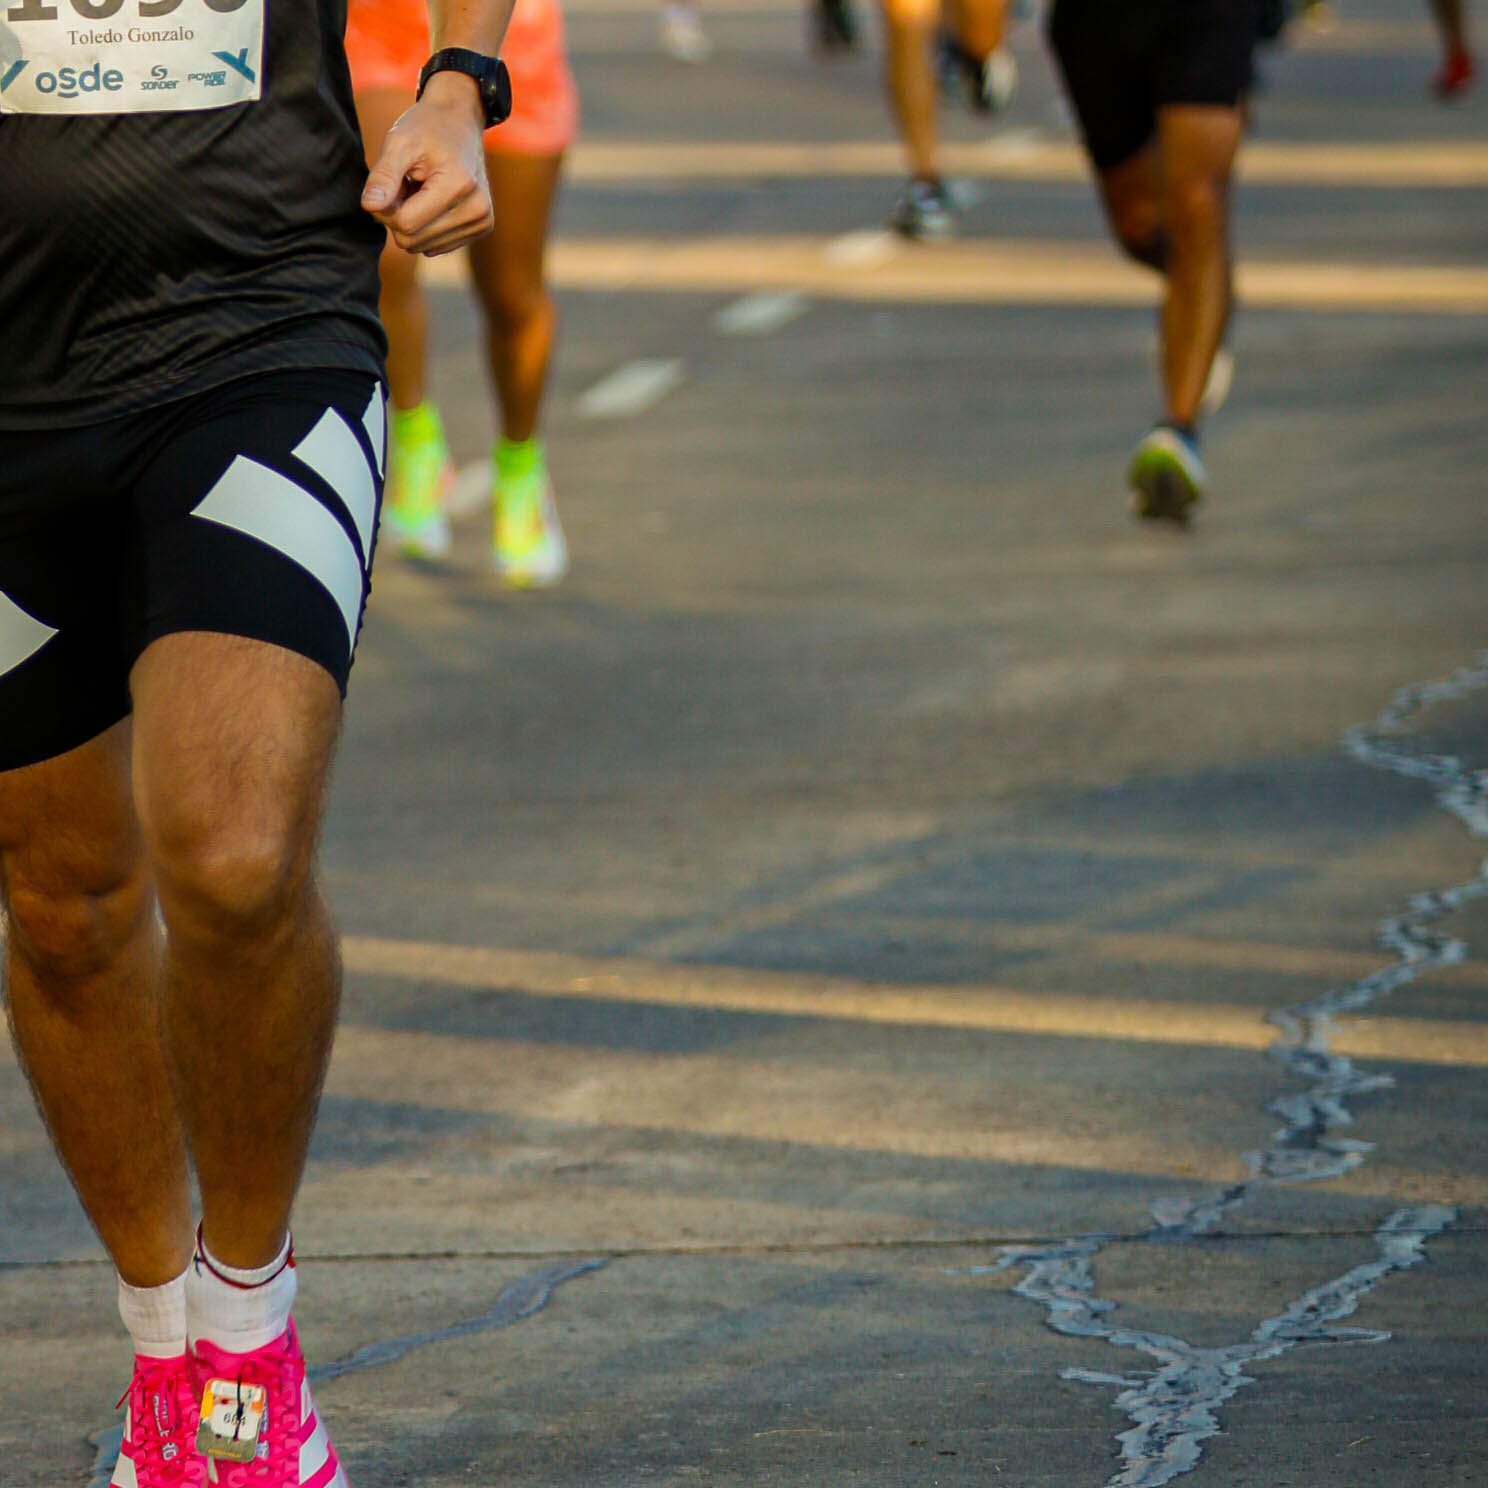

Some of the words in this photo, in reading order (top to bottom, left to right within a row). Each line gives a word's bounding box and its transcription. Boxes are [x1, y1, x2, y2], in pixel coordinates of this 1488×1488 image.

[67, 29, 123, 45] Toledo
[127, 26, 194, 43] Gonzalo
[35, 63, 124, 96] osde
